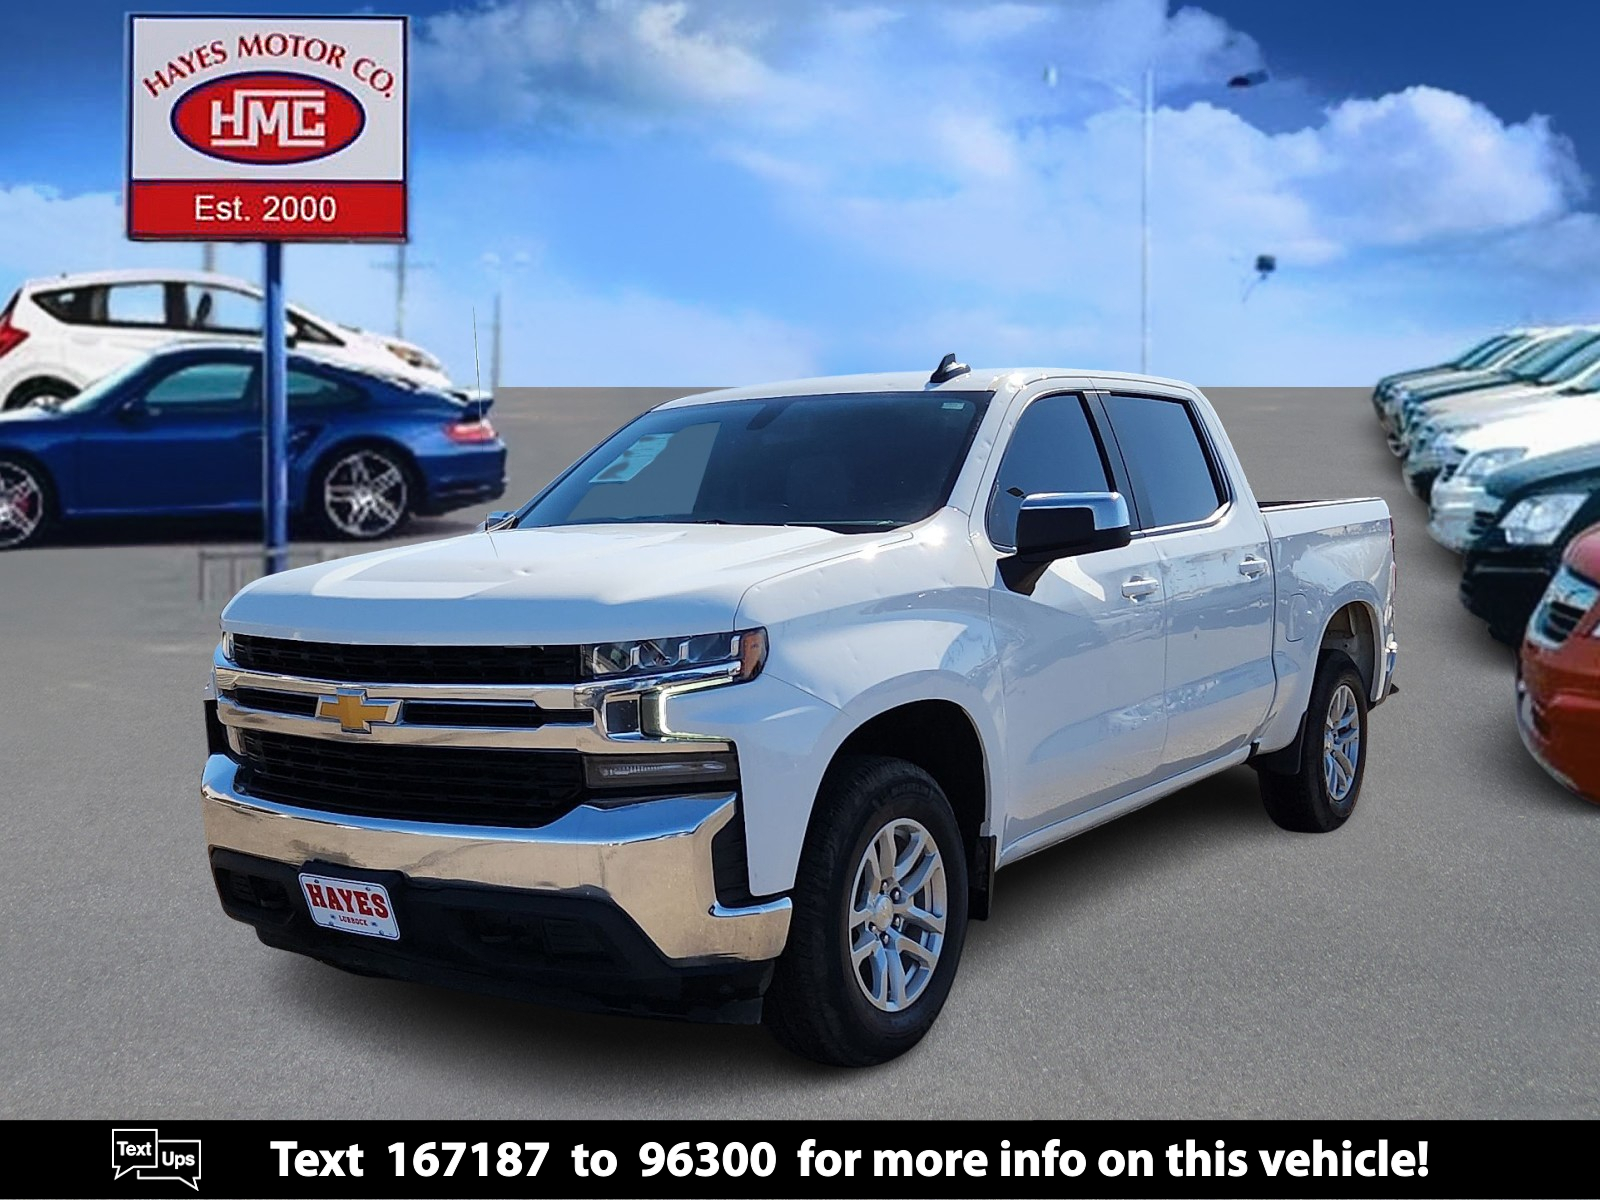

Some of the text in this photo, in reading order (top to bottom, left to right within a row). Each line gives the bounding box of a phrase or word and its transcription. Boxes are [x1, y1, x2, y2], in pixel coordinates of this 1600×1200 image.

[142, 33, 394, 98] HAYES MOTOR CO.
[210, 89, 326, 147] HMC
[195, 195, 337, 222] Est. 2000
[305, 883, 389, 919] HAYES
